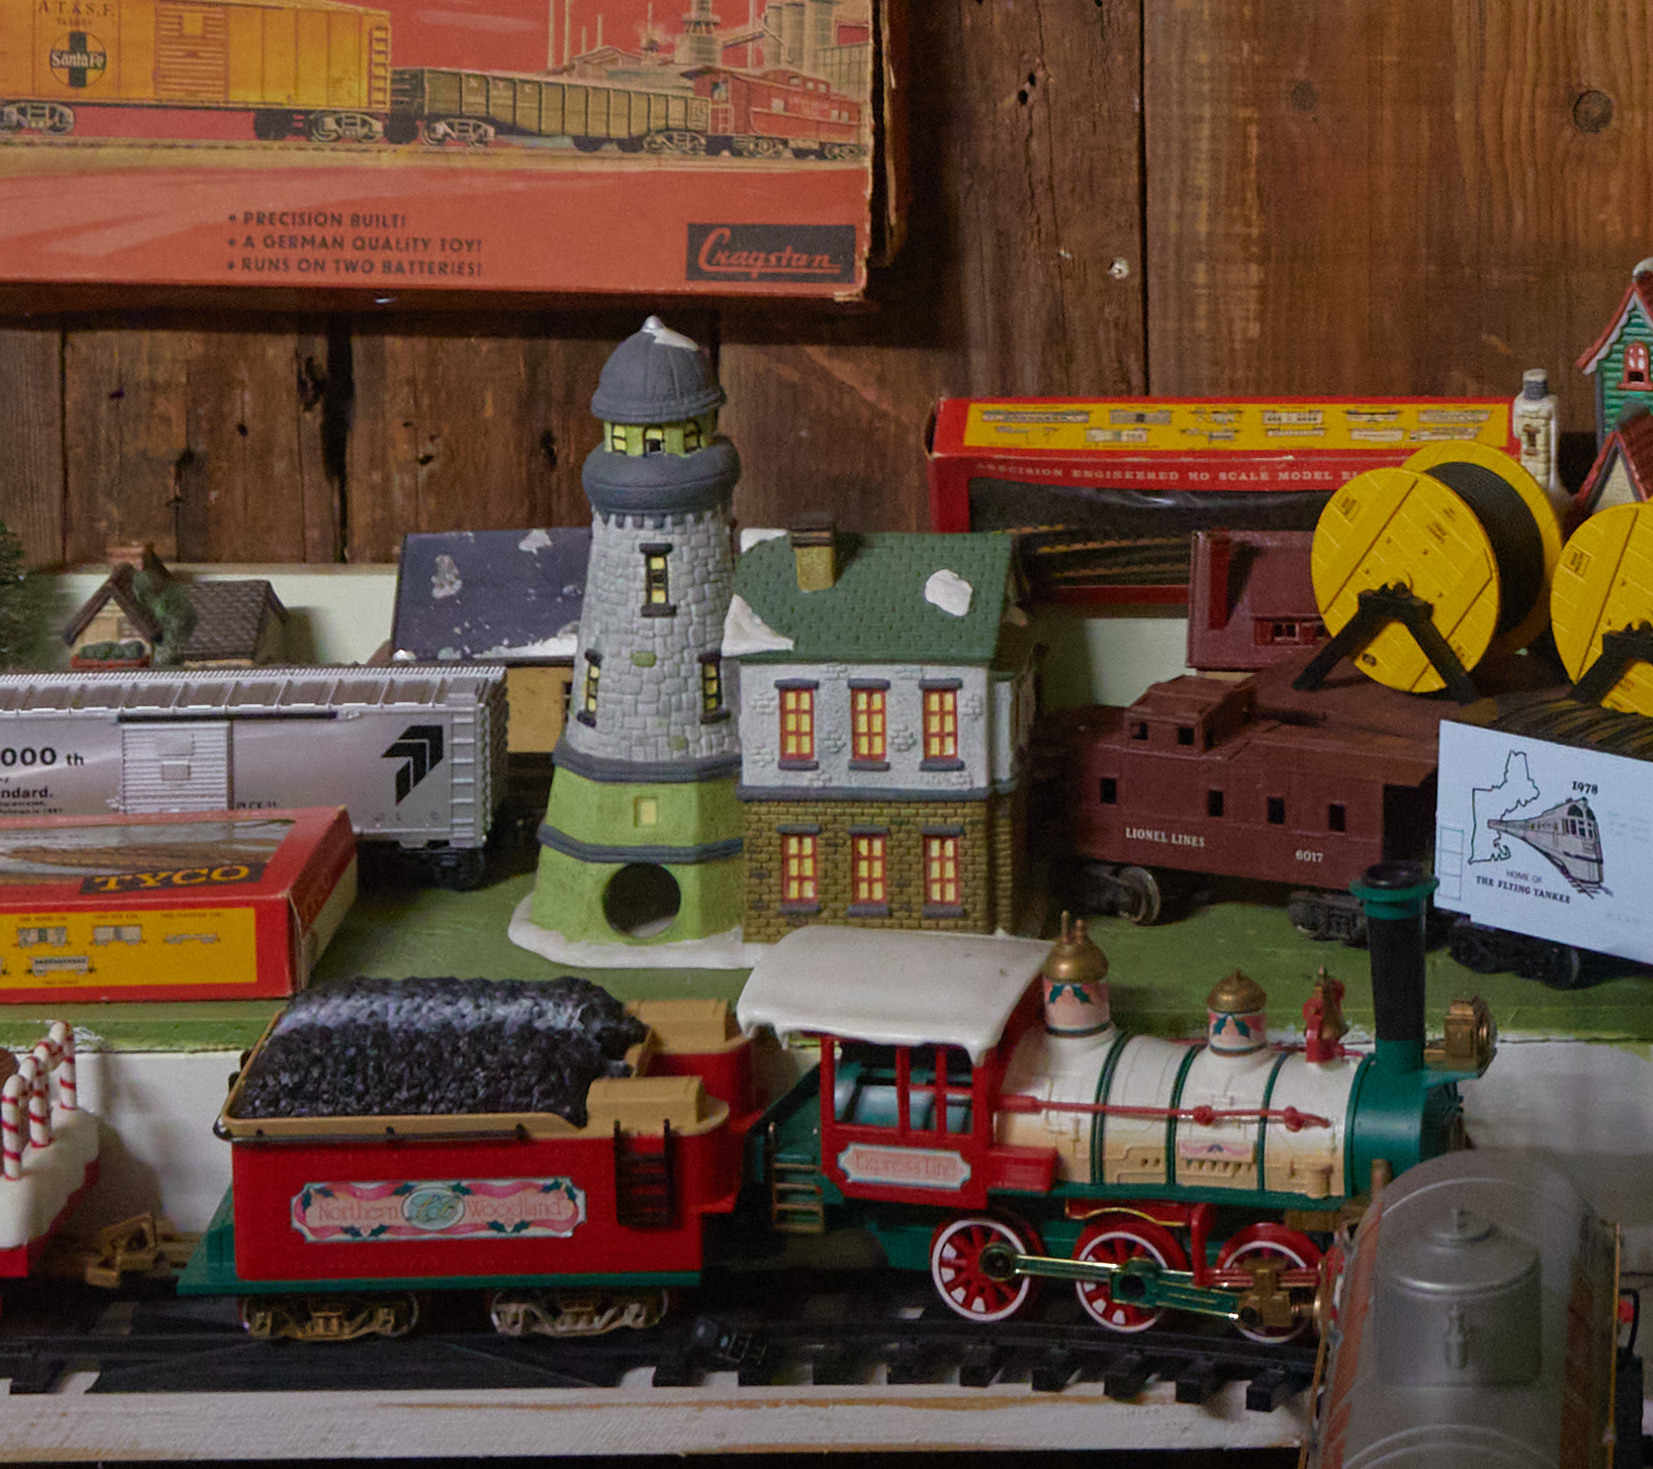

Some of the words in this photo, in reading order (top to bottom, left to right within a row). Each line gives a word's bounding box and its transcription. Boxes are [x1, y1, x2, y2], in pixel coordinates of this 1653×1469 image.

[51, 51, 88, 68] Santa
[242, 211, 343, 227] PRECISION
[350, 213, 407, 229] BUILT!
[243, 235, 256, 249] A
[263, 234, 345, 250] GERMAN
[351, 236, 431, 252] QUALITY
[439, 238, 483, 253] TOY!
[697, 226, 841, 278] Cragstan
[241, 256, 290, 273] RUNS
[296, 258, 326, 274] ON
[334, 259, 375, 275] TWO
[381, 260, 483, 277] BATTERIES!
[1072, 466, 1181, 482] ENGINEERED
[1188, 469, 1210, 482] HO
[1218, 470, 1272, 483] SCALE
[1277, 469, 1335, 482] MODEL
[66, 752, 85, 767] th
[1571, 780, 1599, 796] 1978
[1124, 827, 1168, 844] LIONEL
[1171, 832, 1206, 848] LINES
[1295, 849, 1324, 863] 6017
[94, 865, 250, 892] TYCO
[1506, 869, 1530, 881] HOME
[1533, 875, 1543, 883] OF
[1475, 875, 1495, 888] THE
[1497, 878, 1531, 896] FLYING
[1532, 884, 1572, 905] YANKEE
[320, 1202, 400, 1223] Northern
[467, 1198, 564, 1220] Woodland
